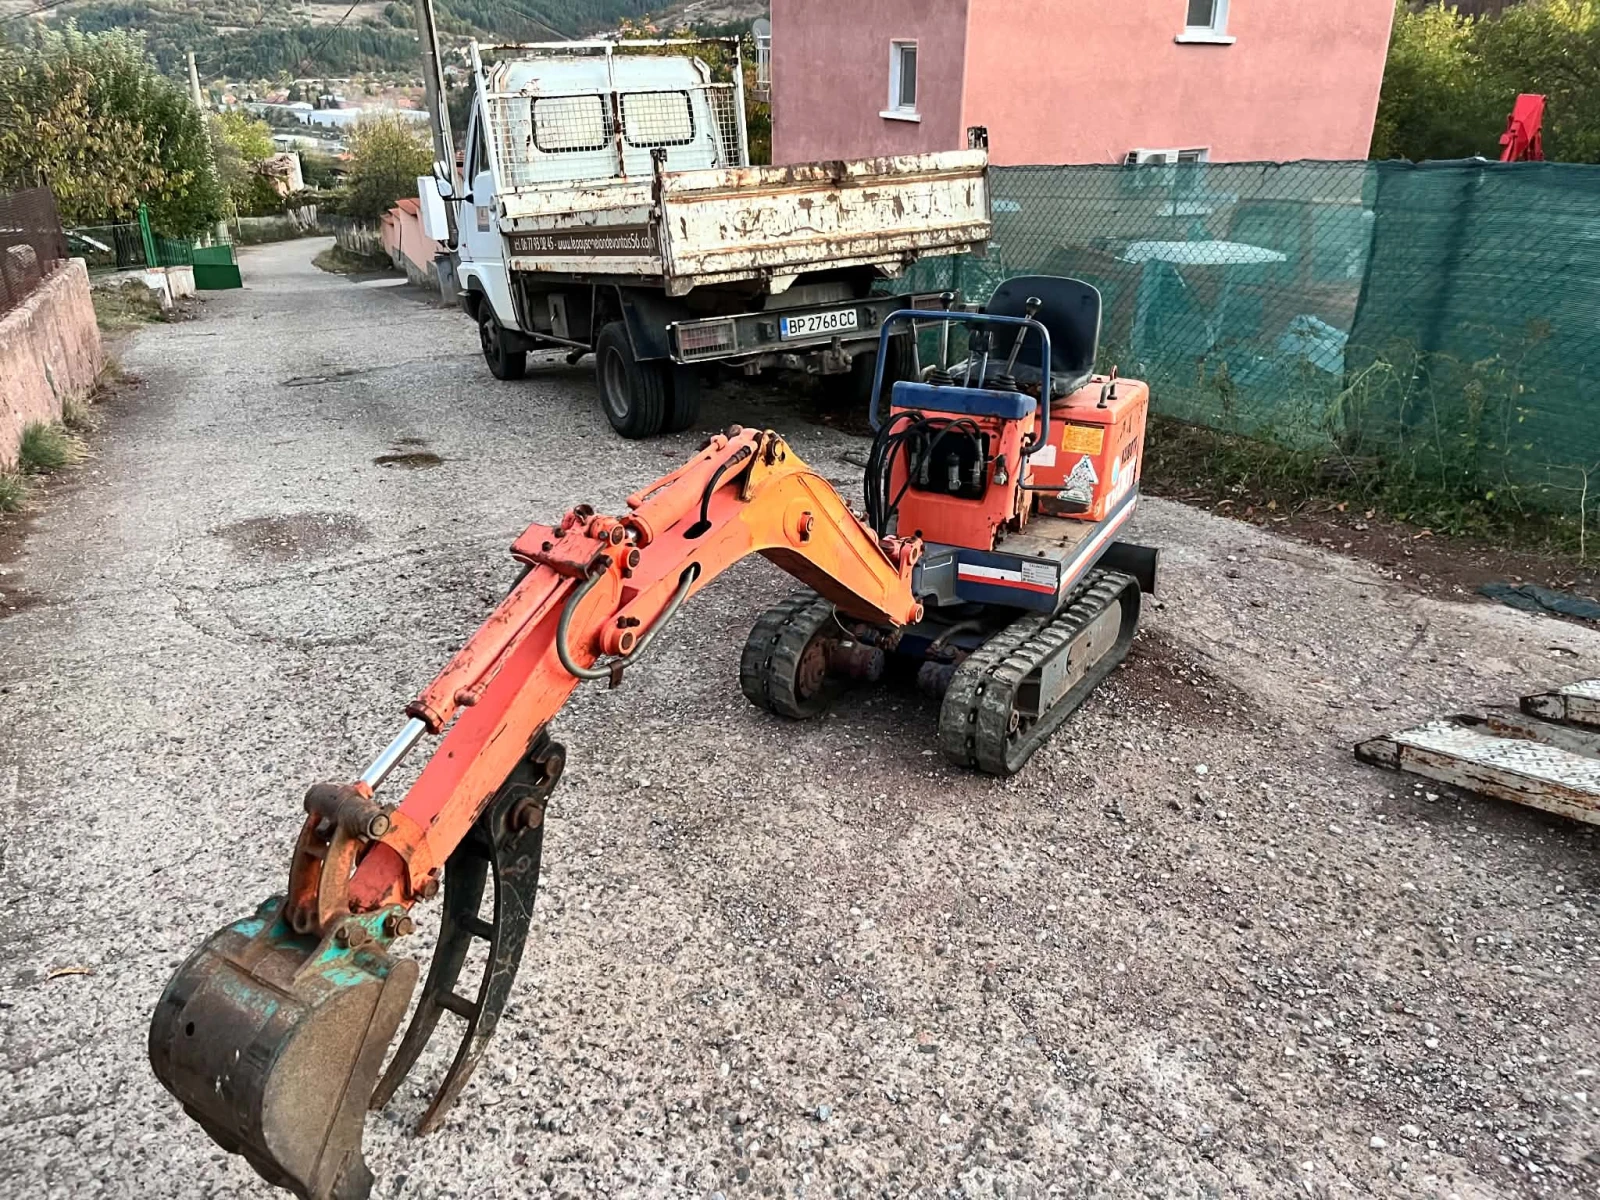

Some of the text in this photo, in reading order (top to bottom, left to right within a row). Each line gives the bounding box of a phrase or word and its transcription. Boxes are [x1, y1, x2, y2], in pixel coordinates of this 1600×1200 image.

[789, 311, 855, 334] BP 2768 CC
